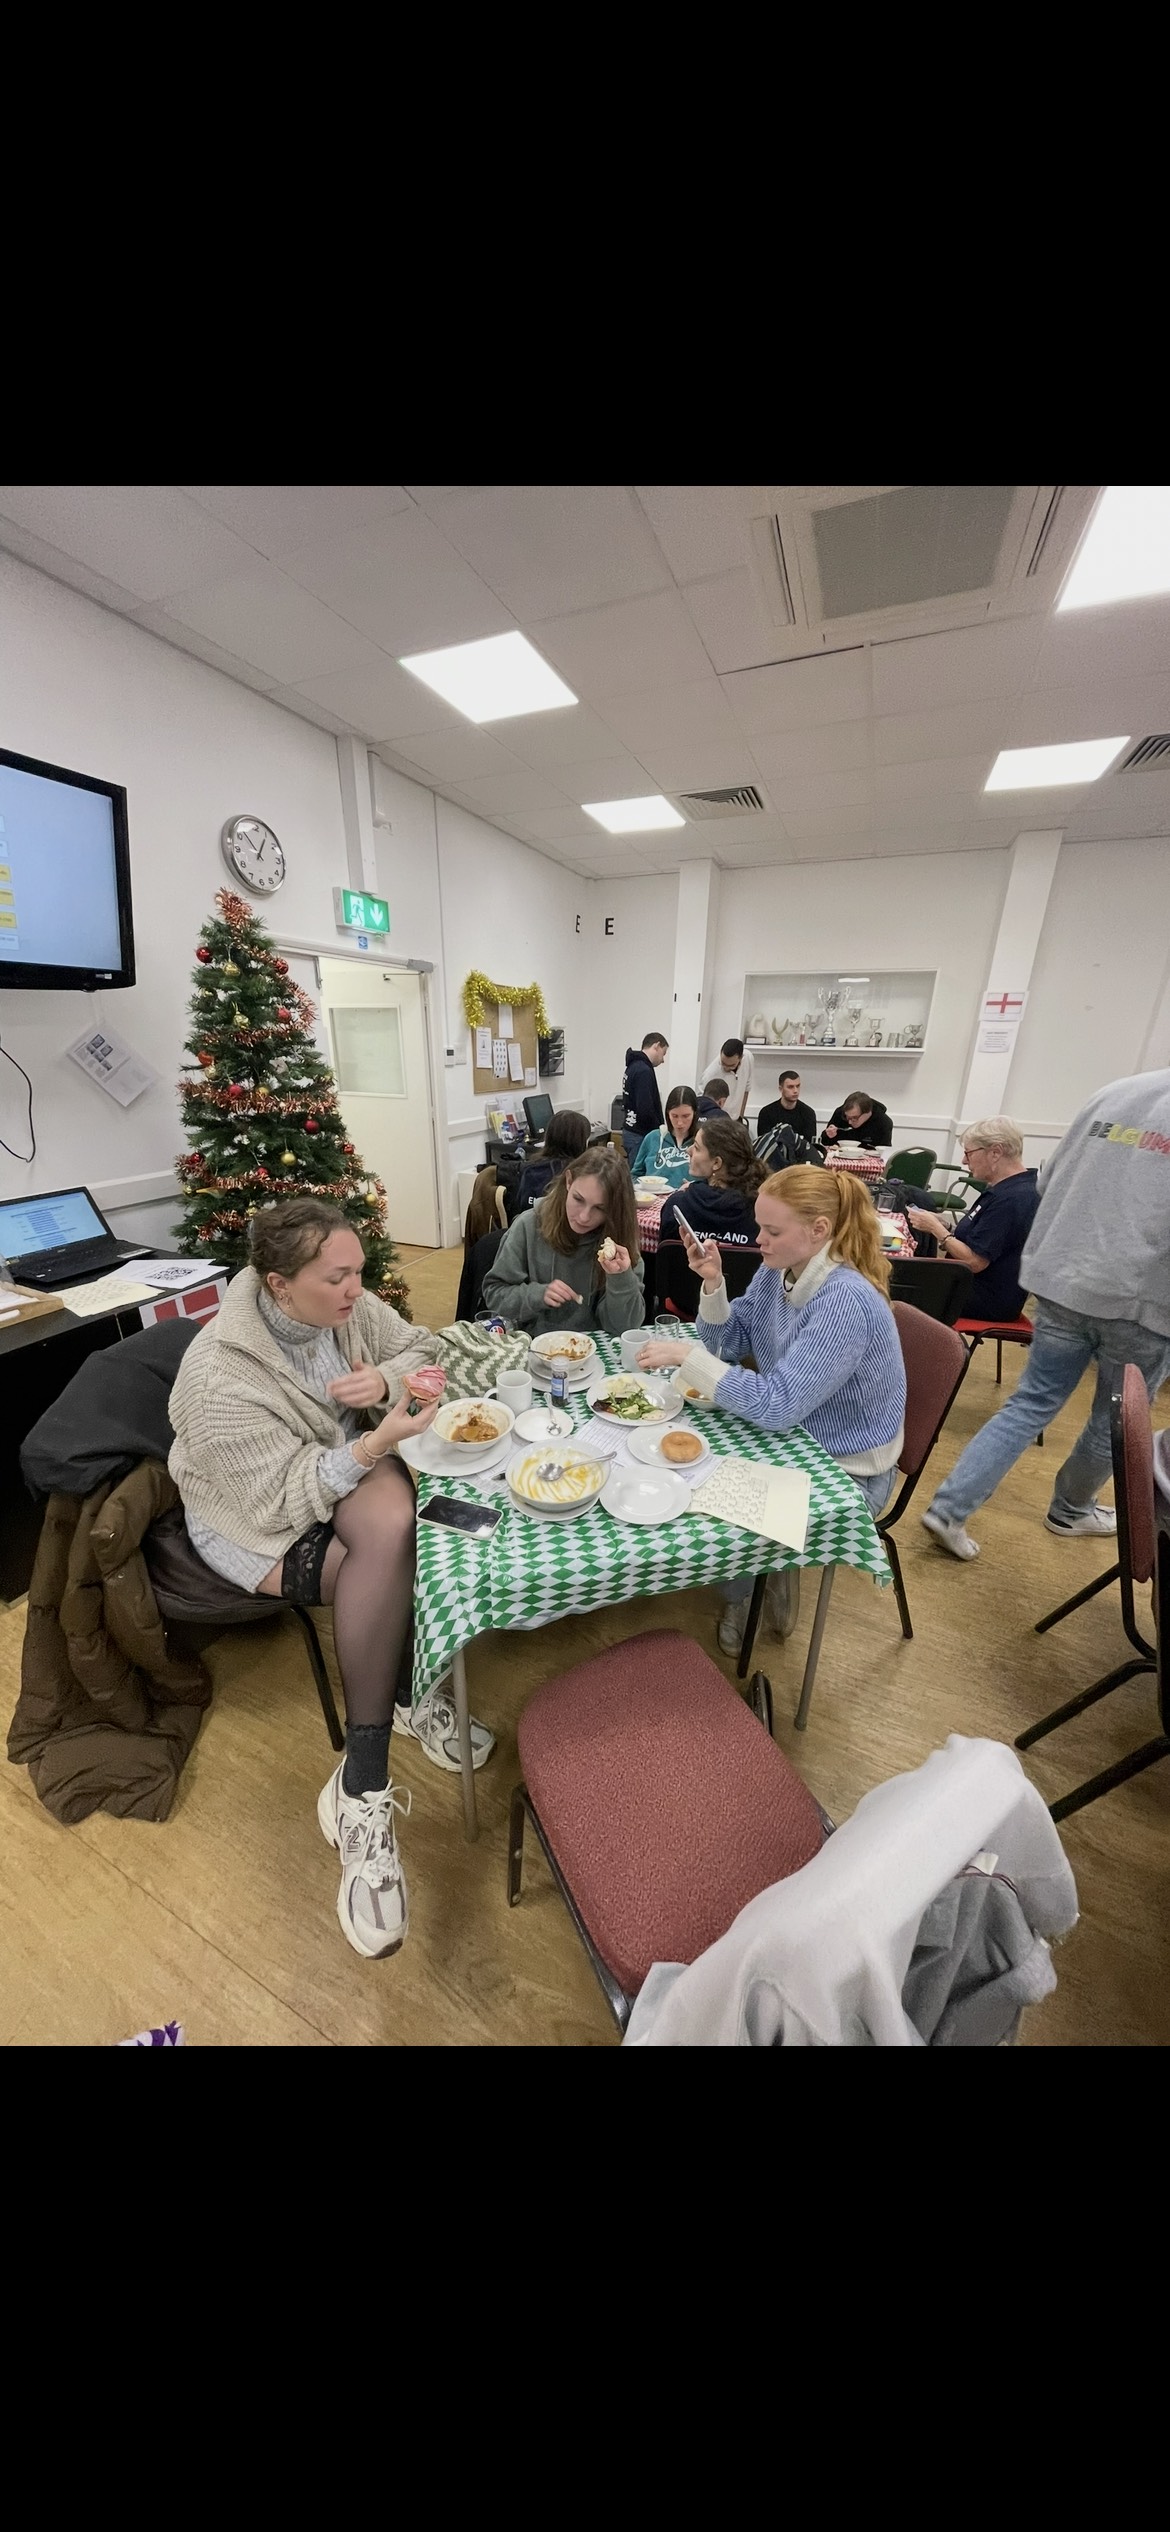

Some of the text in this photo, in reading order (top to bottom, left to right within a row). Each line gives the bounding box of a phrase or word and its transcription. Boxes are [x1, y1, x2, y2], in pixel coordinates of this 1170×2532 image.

[234, 845, 241, 853] 9
[240, 860, 247, 868] 8
[275, 857, 282, 865] 3
[248, 872, 254, 880] 7
[274, 869, 280, 877] 4
[259, 878, 266, 886] 6
[268, 877, 275, 885] 5
[575, 914, 581, 933] E
[605, 917, 614, 935] E
